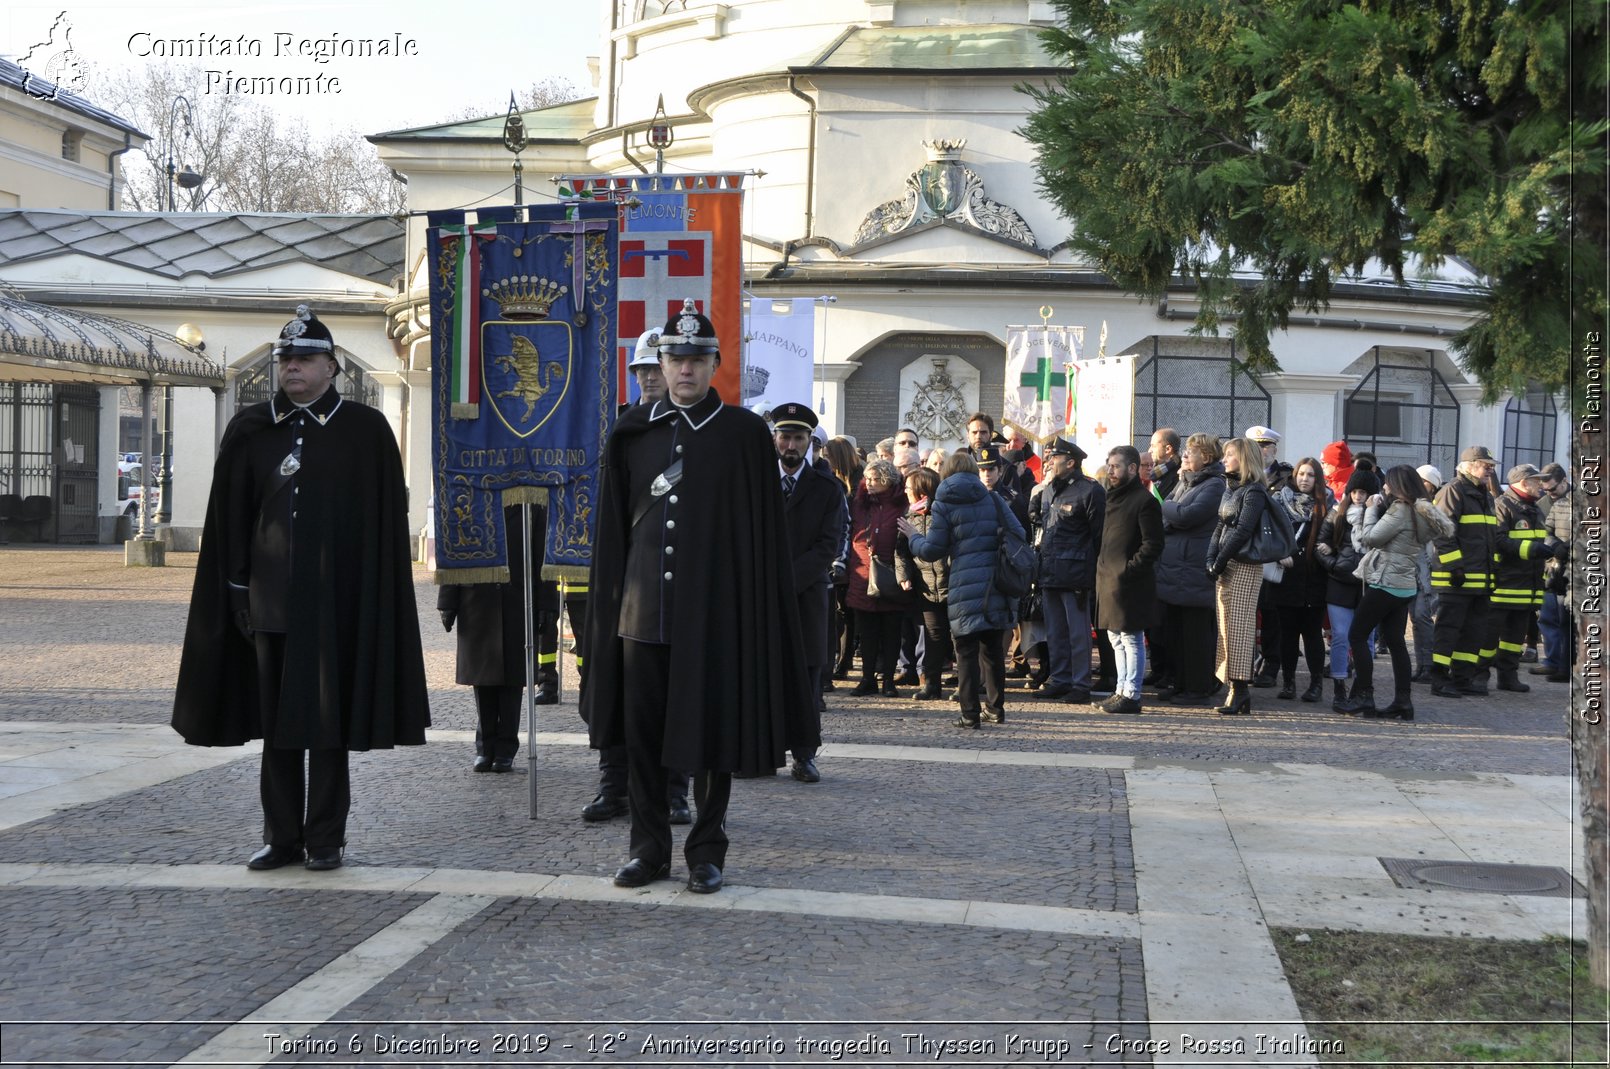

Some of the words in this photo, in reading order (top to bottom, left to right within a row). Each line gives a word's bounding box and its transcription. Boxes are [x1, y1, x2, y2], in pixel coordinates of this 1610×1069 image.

[617, 203, 697, 223] PIEMONTE
[746, 330, 808, 358] MAPPANO
[1015, 339, 1045, 355] COCE
[512, 447, 525, 465] DI
[531, 448, 586, 466] TORINO
